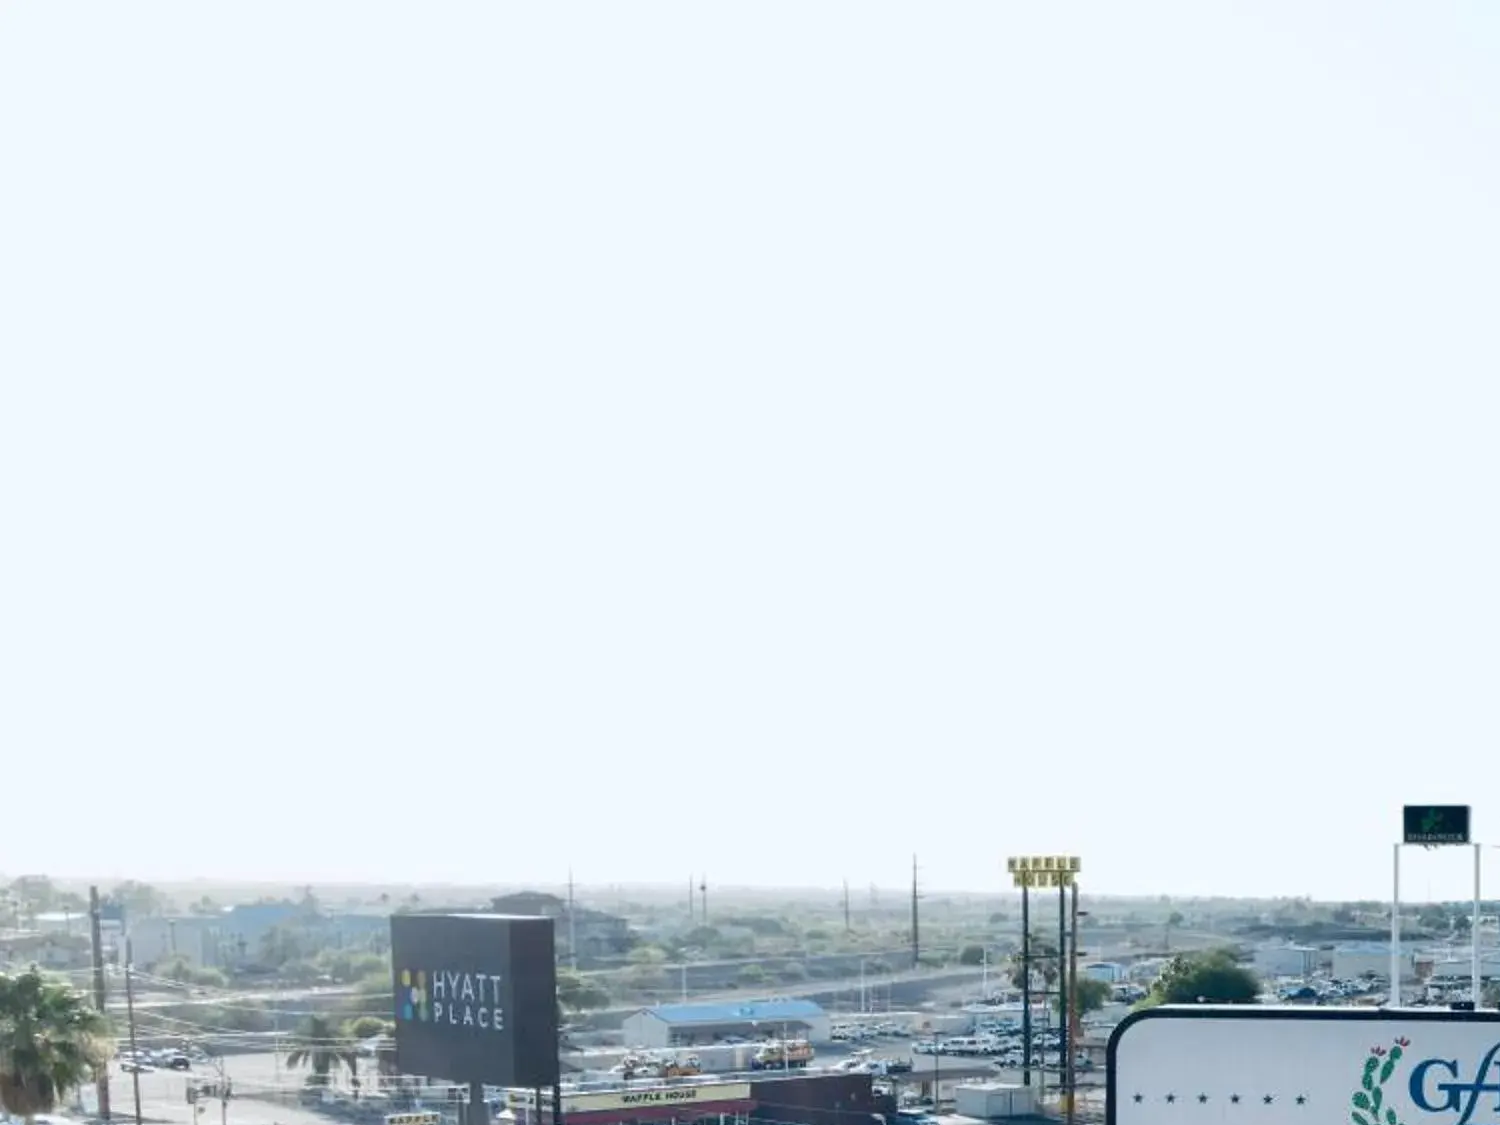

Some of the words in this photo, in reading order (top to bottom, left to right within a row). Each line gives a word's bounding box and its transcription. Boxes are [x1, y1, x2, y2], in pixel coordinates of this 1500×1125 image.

[1007, 856, 1080, 870] WAFFLE
[432, 970, 501, 1003] HYATT
[434, 1001, 504, 1030] PLACE
[623, 1093, 660, 1103] WAFFLE
[665, 1089, 697, 1100] HOUSE
